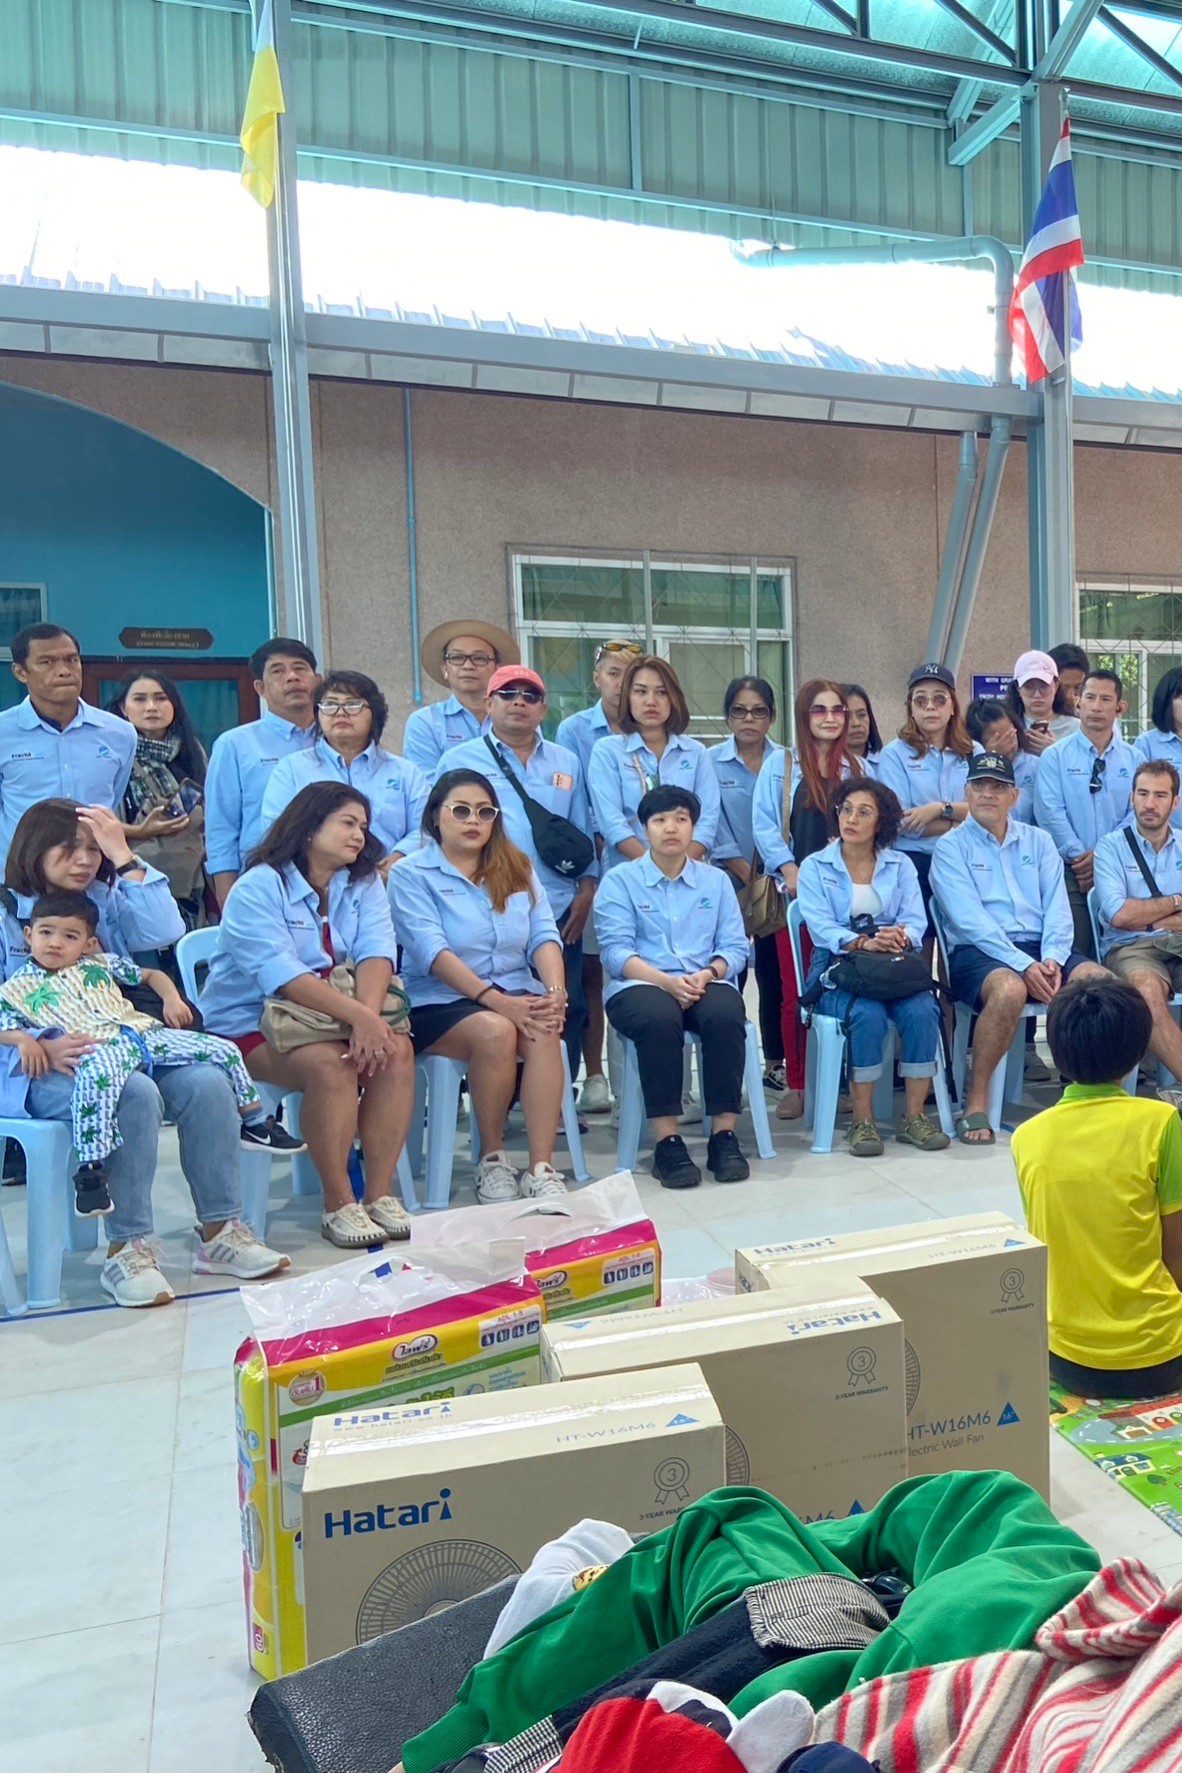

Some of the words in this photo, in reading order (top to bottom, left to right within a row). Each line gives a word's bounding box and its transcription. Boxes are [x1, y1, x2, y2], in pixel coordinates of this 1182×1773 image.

[1008, 1276, 1016, 1287] 3
[787, 1311, 882, 1335] Hatari
[857, 1355, 866, 1368] 3
[856, 1385, 889, 1397] WARRANTY
[334, 1401, 451, 1427] Hatari
[556, 1423, 656, 1443] HT-W16M6
[908, 1443, 939, 1457] lectric
[942, 1437, 964, 1449] Wall
[966, 1433, 985, 1444] Fan
[666, 1467, 678, 1482] 3
[324, 1487, 452, 1539] Hatari
[639, 1510, 664, 1521] 3-YEAR
